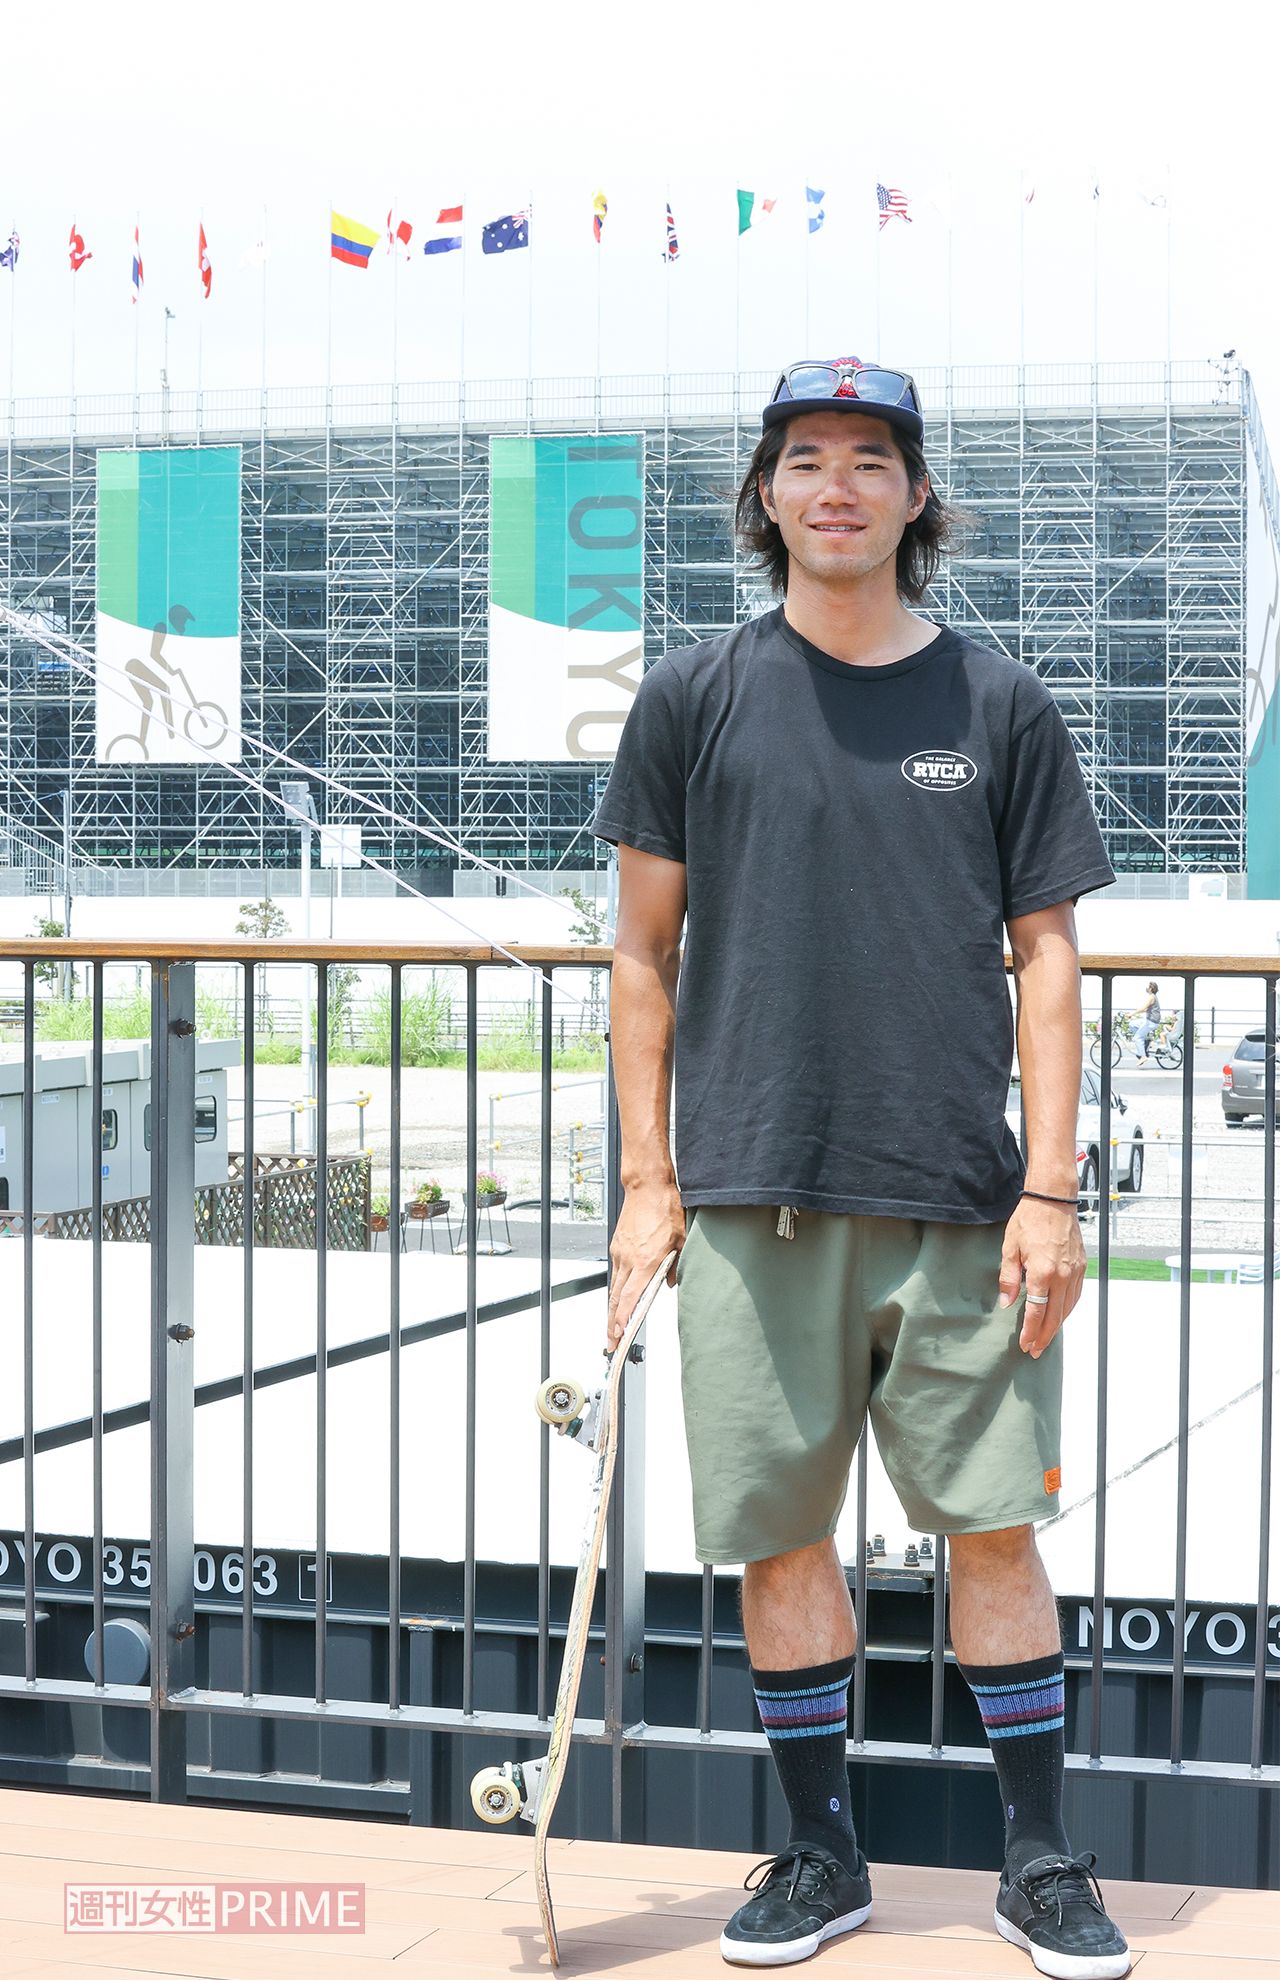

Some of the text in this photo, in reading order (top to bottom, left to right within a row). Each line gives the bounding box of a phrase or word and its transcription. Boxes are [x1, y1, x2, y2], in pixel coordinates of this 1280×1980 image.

[912, 761, 968, 779] RVCA
[0, 1540, 82, 1583] YO
[1078, 1605, 1247, 1656] NOYO
